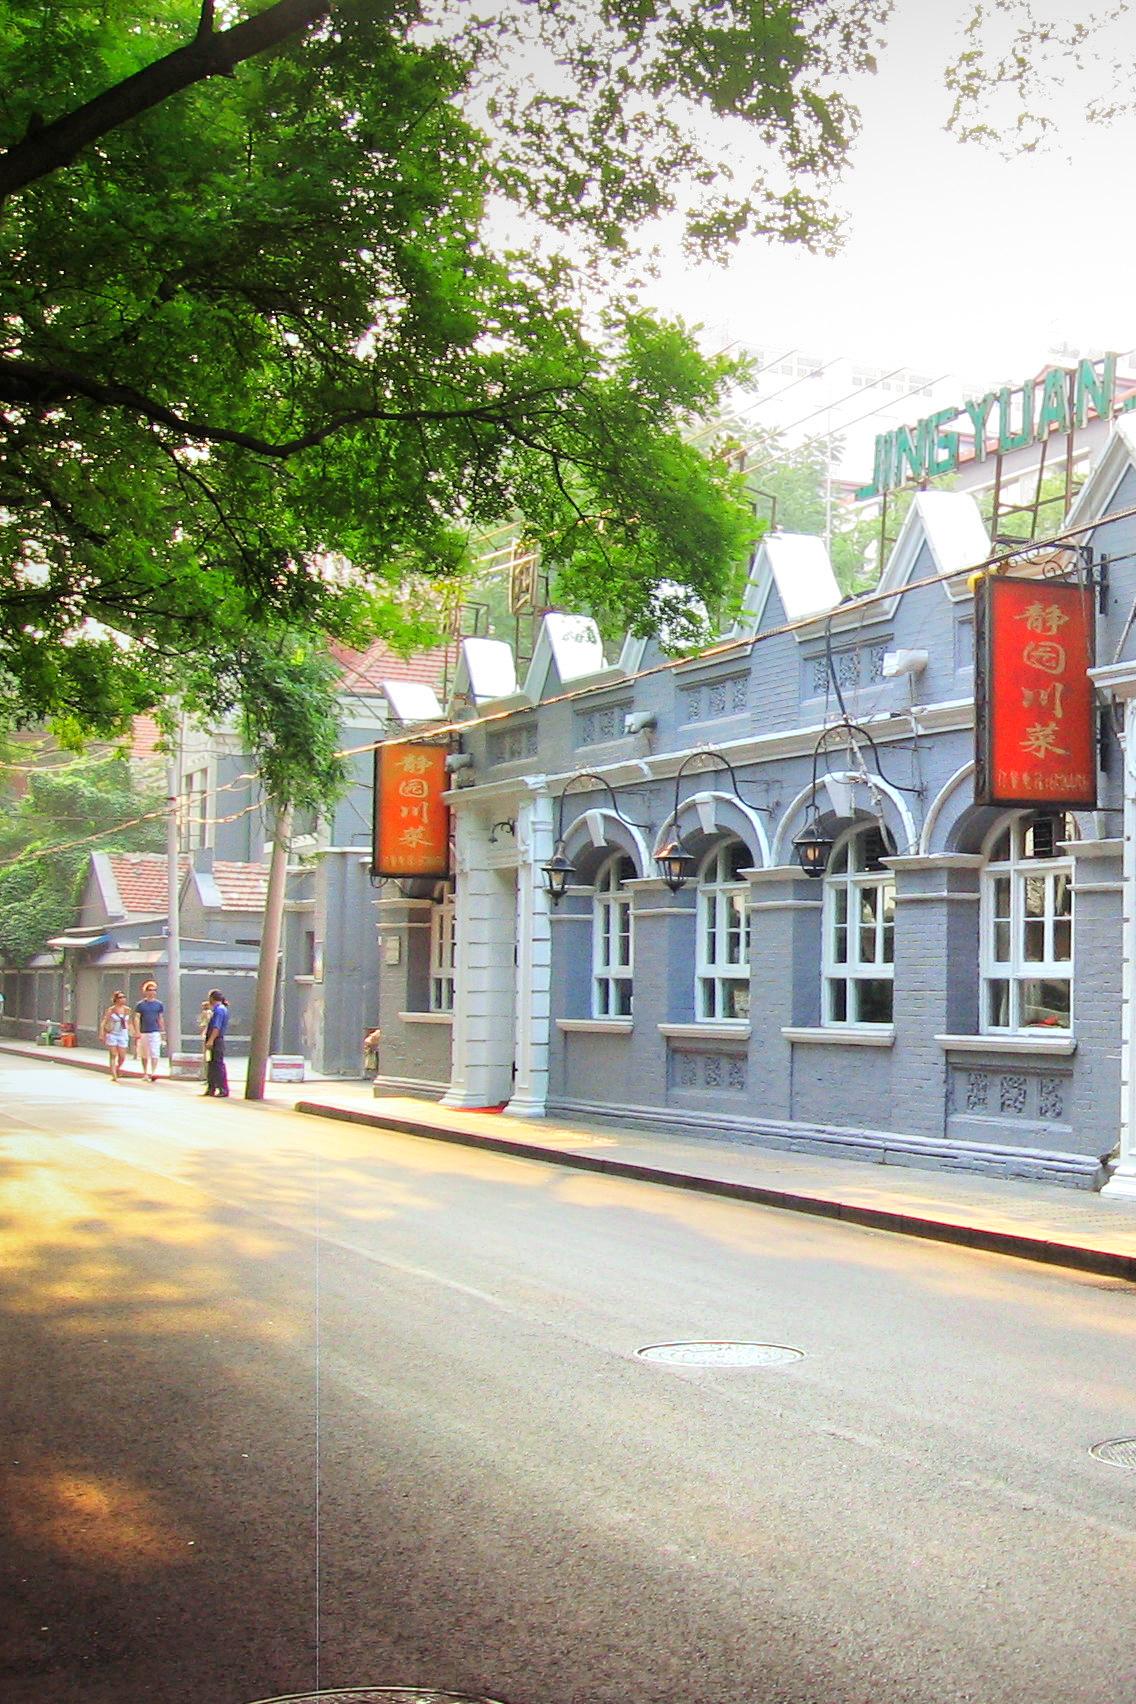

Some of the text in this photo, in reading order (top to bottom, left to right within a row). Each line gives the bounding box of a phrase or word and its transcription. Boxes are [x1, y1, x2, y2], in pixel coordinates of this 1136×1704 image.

[855, 351, 1117, 499] JINGYUAN
[1013, 601, 1070, 759] 静园川菜
